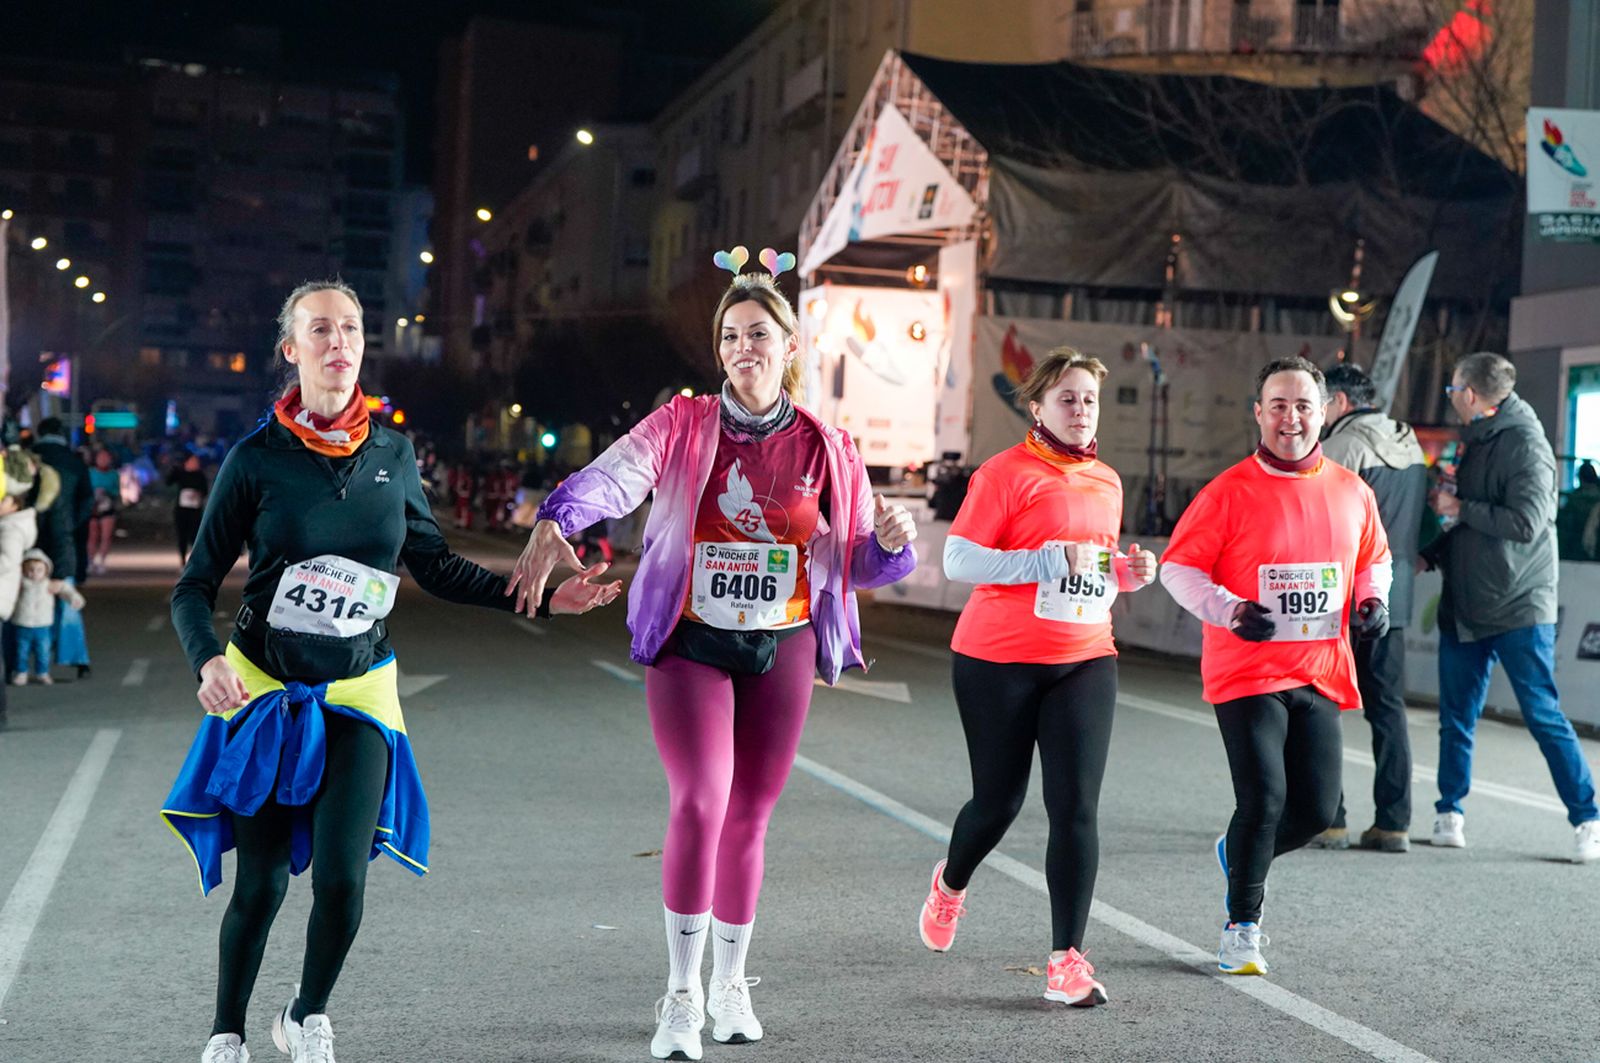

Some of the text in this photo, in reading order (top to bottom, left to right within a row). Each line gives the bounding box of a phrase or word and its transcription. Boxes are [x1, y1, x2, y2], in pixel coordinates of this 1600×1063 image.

[735, 509, 761, 532] 43
[718, 550, 760, 561] NOCHE DE
[311, 562, 343, 581] NOCHE
[344, 574, 358, 585] DE
[705, 560, 726, 571] SAN
[727, 560, 759, 572] ANTÓN
[295, 570, 318, 584] SAN
[1305, 572, 1315, 580] DE
[711, 572, 777, 602] 6406
[1269, 582, 1286, 591] SAN
[284, 583, 369, 619] 4316
[1277, 591, 1329, 615] 1992
